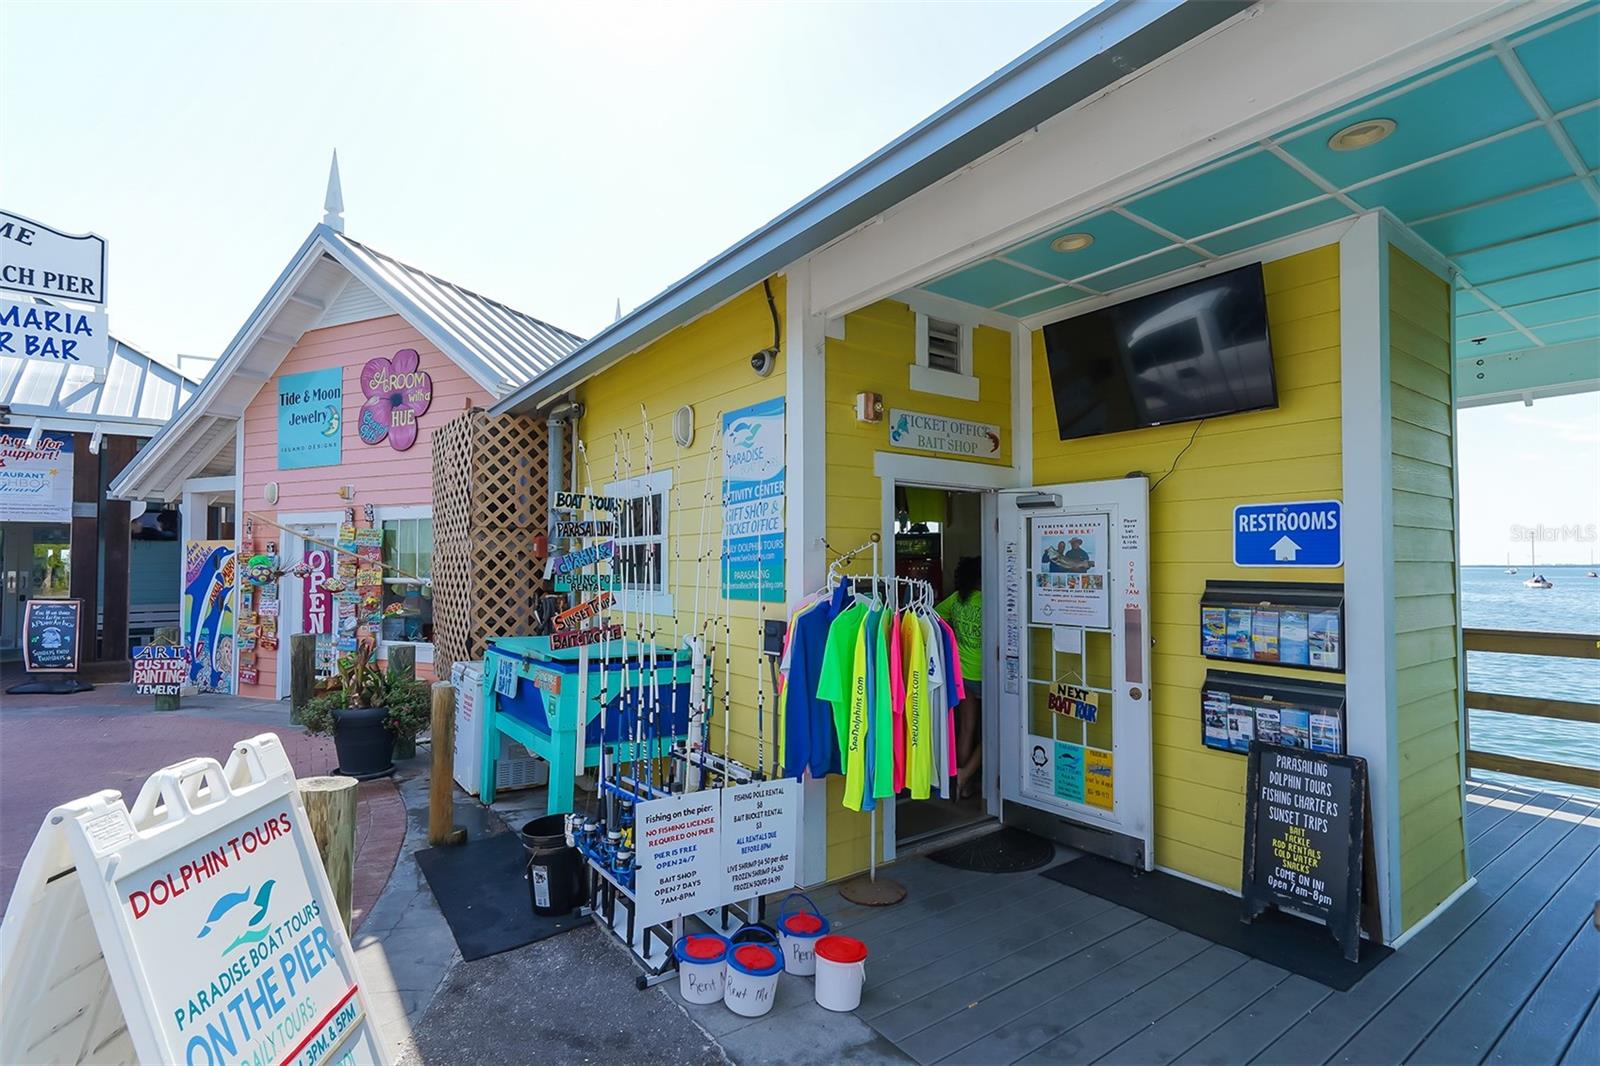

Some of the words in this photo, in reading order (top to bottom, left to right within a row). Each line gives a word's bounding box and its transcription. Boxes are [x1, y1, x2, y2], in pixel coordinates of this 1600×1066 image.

[0, 265, 35, 286] CH
[43, 271, 95, 296] PIER
[0, 305, 93, 337] MARIA
[25, 334, 80, 361] BAR
[389, 373, 425, 391] ROOM
[280, 392, 301, 406] Tide
[303, 390, 311, 403] &
[313, 388, 341, 401] Moon
[408, 389, 424, 402] with
[289, 410, 327, 425] Jewelry
[391, 409, 415, 428] HUE
[40, 438, 64, 450] for
[917, 435, 946, 450] BAIT
[948, 439, 978, 454] SHOP
[754, 481, 785, 497] CENTER
[556, 492, 585, 509] BOAT
[744, 502, 769, 519] SHOP
[1239, 510, 1337, 532] RESTROOMS
[308, 550, 326, 634] OPEN
[554, 607, 591, 631] SUNSET
[134, 645, 185, 659] ART
[135, 659, 186, 670] CUSTOM
[133, 669, 185, 684] PAINTING
[136, 684, 179, 695] JEWELRY
[1057, 684, 1089, 702] NEXT
[850, 676, 864, 752] SeeDolphins.com
[1048, 692, 1076, 715] BOAT
[1074, 701, 1097, 722] TOUR
[1276, 755, 1328, 777] PARASAILING
[1269, 771, 1302, 791] DOLPHIN
[1305, 777, 1332, 797] TOURS
[734, 792, 752, 801] FISHING
[753, 790, 765, 798] POLE
[766, 787, 784, 796] RENTAL
[1262, 787, 1292, 806] FISHING
[1294, 794, 1338, 817] CHARTERS
[646, 813, 671, 824] Fishing
[683, 808, 696, 816] the
[697, 804, 713, 815] pier:
[734, 814, 745, 823] BAIT
[745, 810, 764, 820] BUCKET
[764, 808, 783, 817] RENTAL
[1269, 806, 1300, 826] SUNSET
[1303, 813, 1328, 833] TRIPS
[646, 829, 657, 837] NO
[658, 823, 686, 834] FISHING
[687, 817, 715, 828] LICENSE
[1289, 826, 1306, 837] BAIT
[649, 833, 685, 847] REQUIRED
[686, 830, 698, 838] ON
[698, 827, 714, 836] PIER
[736, 837, 745, 845] ALL
[745, 832, 767, 843] RENTALS
[768, 831, 777, 839] DUE
[1284, 832, 1311, 847] TACKLE
[654, 851, 670, 860] PIER
[679, 845, 697, 854] FREE
[741, 844, 760, 854] BEFORE
[1272, 838, 1286, 849] ROD
[1287, 843, 1321, 860] RENTALS
[1274, 848, 1291, 860] COLD
[1292, 852, 1318, 868] WATER
[129, 847, 228, 919] DOLPHIN
[227, 812, 293, 862] TOURS
[656, 860, 677, 869] OPEN
[678, 855, 696, 864] 24/7
[727, 864, 738, 873] LIVE
[738, 860, 757, 870] SHRIMP
[771, 856, 779, 865] per
[1282, 859, 1310, 874] SNACKS
[659, 875, 676, 885] BAIT
[677, 870, 697, 881] SHOP
[732, 871, 752, 882] FROZEN
[752, 867, 770, 877] SHRIMP
[1275, 867, 1296, 881] COME
[1298, 874, 1310, 886] ON
[1312, 878, 1325, 892] IN!
[654, 886, 676, 896] OPEN
[682, 880, 701, 889] DAYS
[733, 882, 753, 891] FROZEN
[1268, 875, 1287, 890] Open
[1290, 881, 1332, 905] 7am-8pm
[660, 891, 696, 905] 7AM-8PM
[174, 956, 251, 1031] PARADISE
[249, 928, 285, 968] BOAT
[284, 899, 321, 940] TOURS
[688, 973, 715, 996] Rent
[186, 1011, 238, 1066] ON
[226, 966, 286, 1042] THE
[279, 925, 336, 997] PIER
[277, 996, 318, 1047] TOURS:
[328, 1026, 337, 1041] &
[335, 1002, 356, 1032] 5PM
